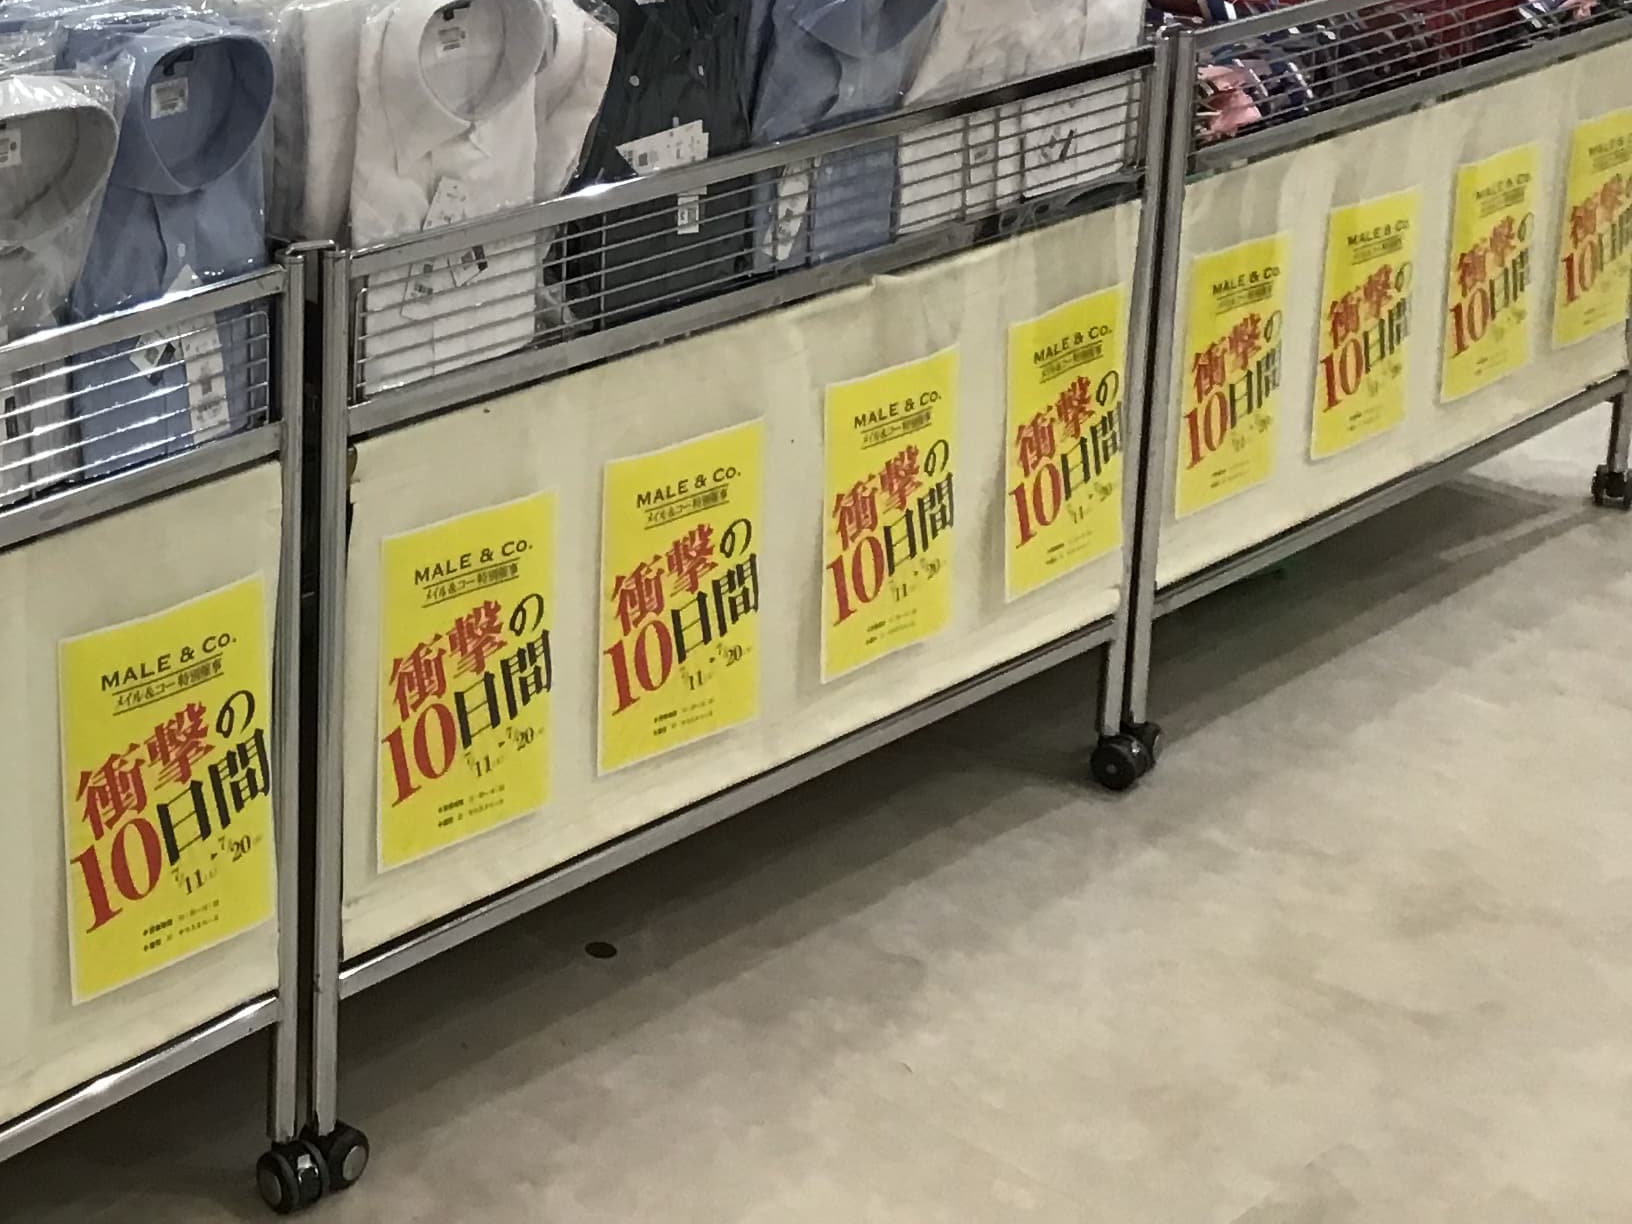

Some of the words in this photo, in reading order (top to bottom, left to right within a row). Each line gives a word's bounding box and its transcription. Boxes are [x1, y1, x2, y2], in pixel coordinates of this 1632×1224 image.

[853, 402, 899, 430] MALE
[904, 395, 917, 410] &
[1033, 336, 1070, 365] MALE
[636, 479, 689, 508] MALE
[694, 474, 708, 489] &
[1007, 400, 1124, 550] 10日間
[414, 553, 472, 586] MALE
[480, 547, 495, 563] &
[610, 517, 753, 638] 衝撃の
[826, 471, 954, 627] 10日間
[100, 653, 172, 693] MALE
[179, 646, 196, 664] &
[388, 592, 545, 723] 衝撃の
[603, 553, 759, 717] 10日間
[75, 689, 256, 841] 衝撃の
[381, 628, 553, 809] 10日間
[70, 727, 271, 935] 10日間
